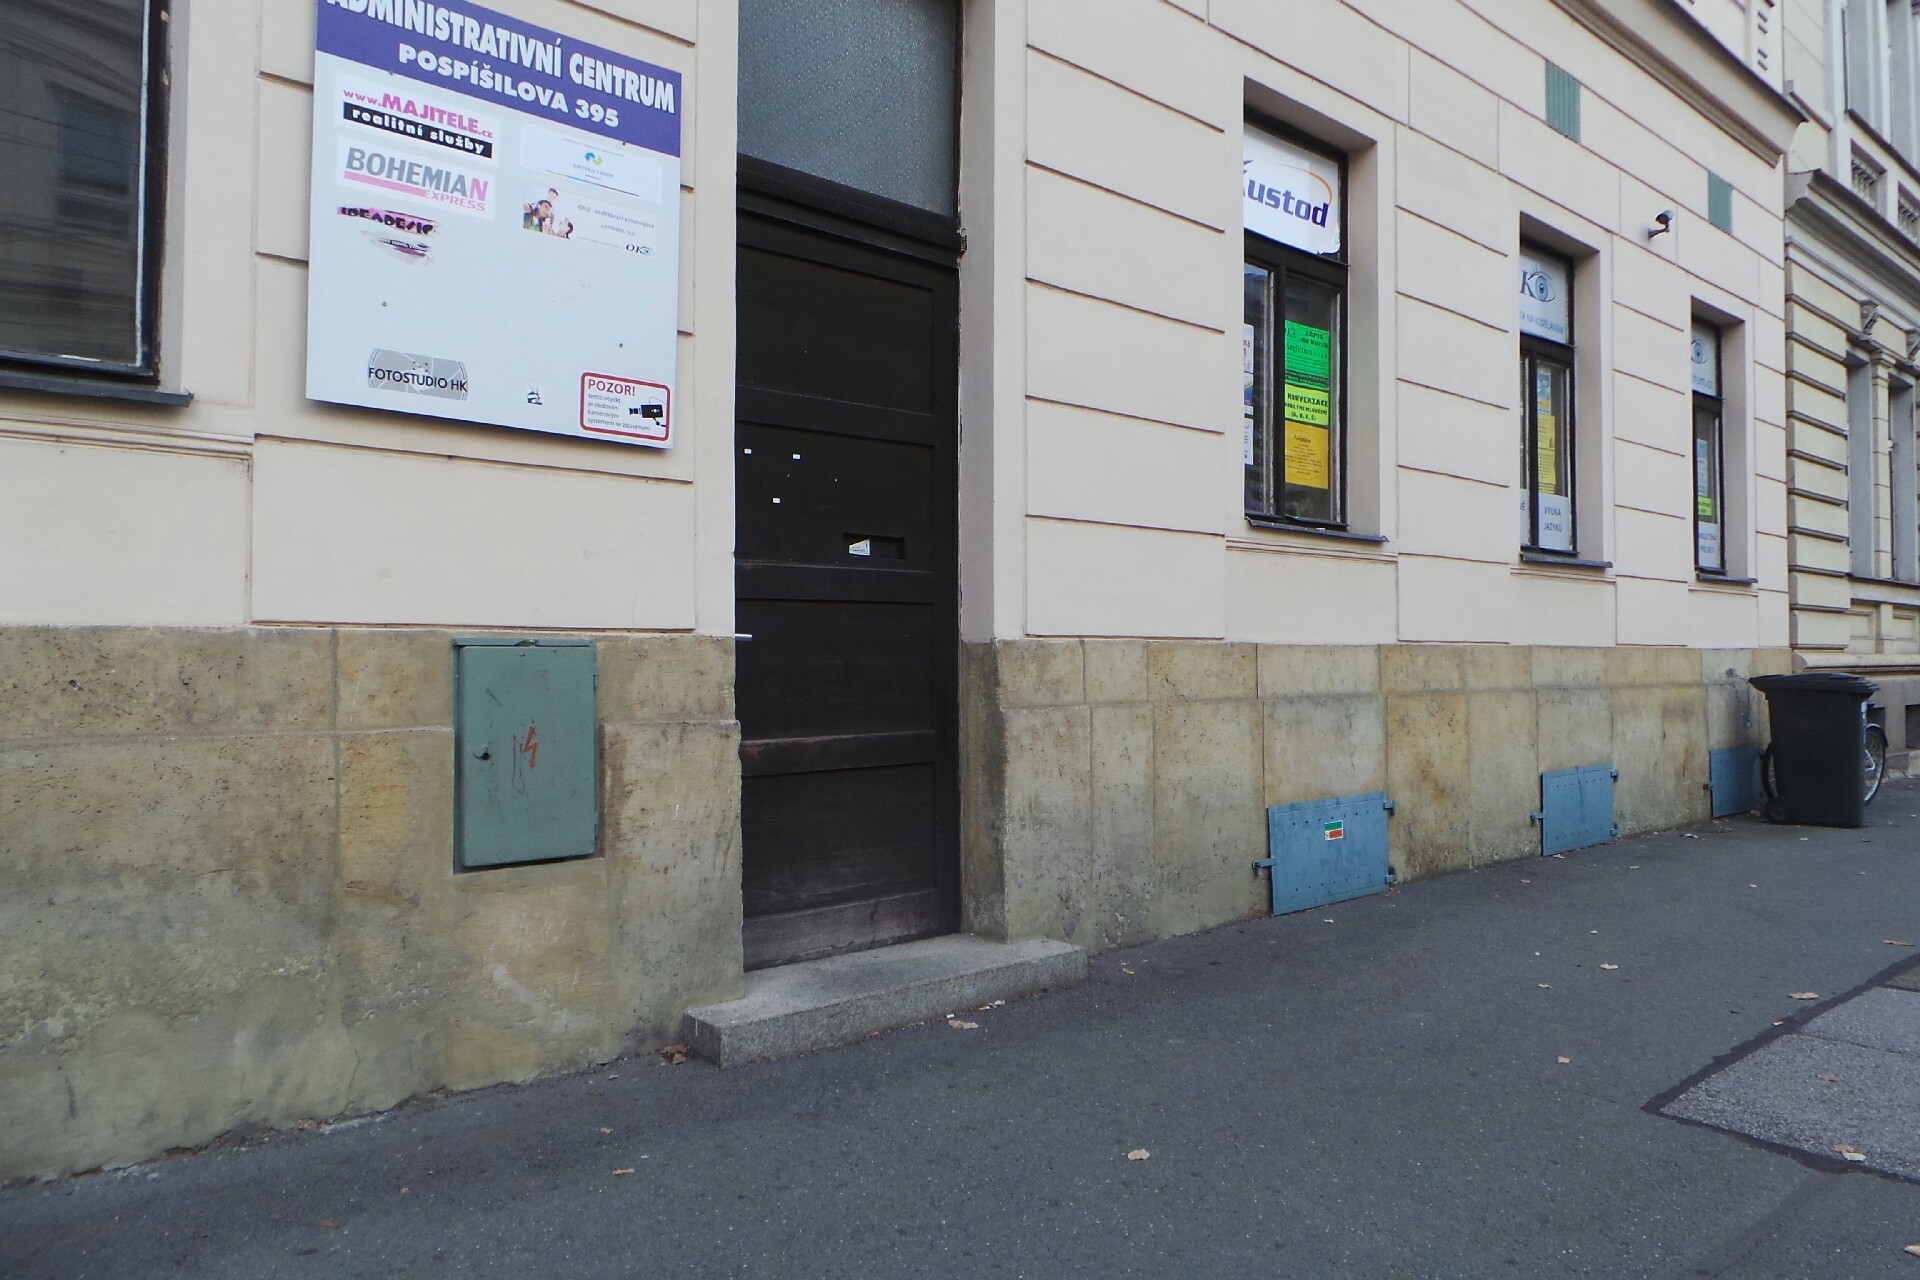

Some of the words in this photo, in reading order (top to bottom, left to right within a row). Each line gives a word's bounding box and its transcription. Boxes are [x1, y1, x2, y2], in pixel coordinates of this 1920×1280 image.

[326, 0, 562, 78] MINISTRATIVNÍ
[569, 52, 676, 114] CENTRUM
[398, 42, 569, 113] POSPÍŠILOVA
[575, 99, 619, 128] 395
[343, 89, 494, 139] www.MAJITELE.cz
[352, 108, 423, 136] realitní
[430, 130, 485, 155] služby
[346, 146, 489, 202] BOHEMIAN
[1243, 160, 1329, 228] ustod
[424, 189, 486, 212] EXPRESS
[368, 367, 448, 389] FOTOSTUDIO
[450, 379, 468, 392] HK
[588, 379, 636, 397] POZOR!
[588, 393, 602, 401] tento
[604, 395, 621, 404] objekt
